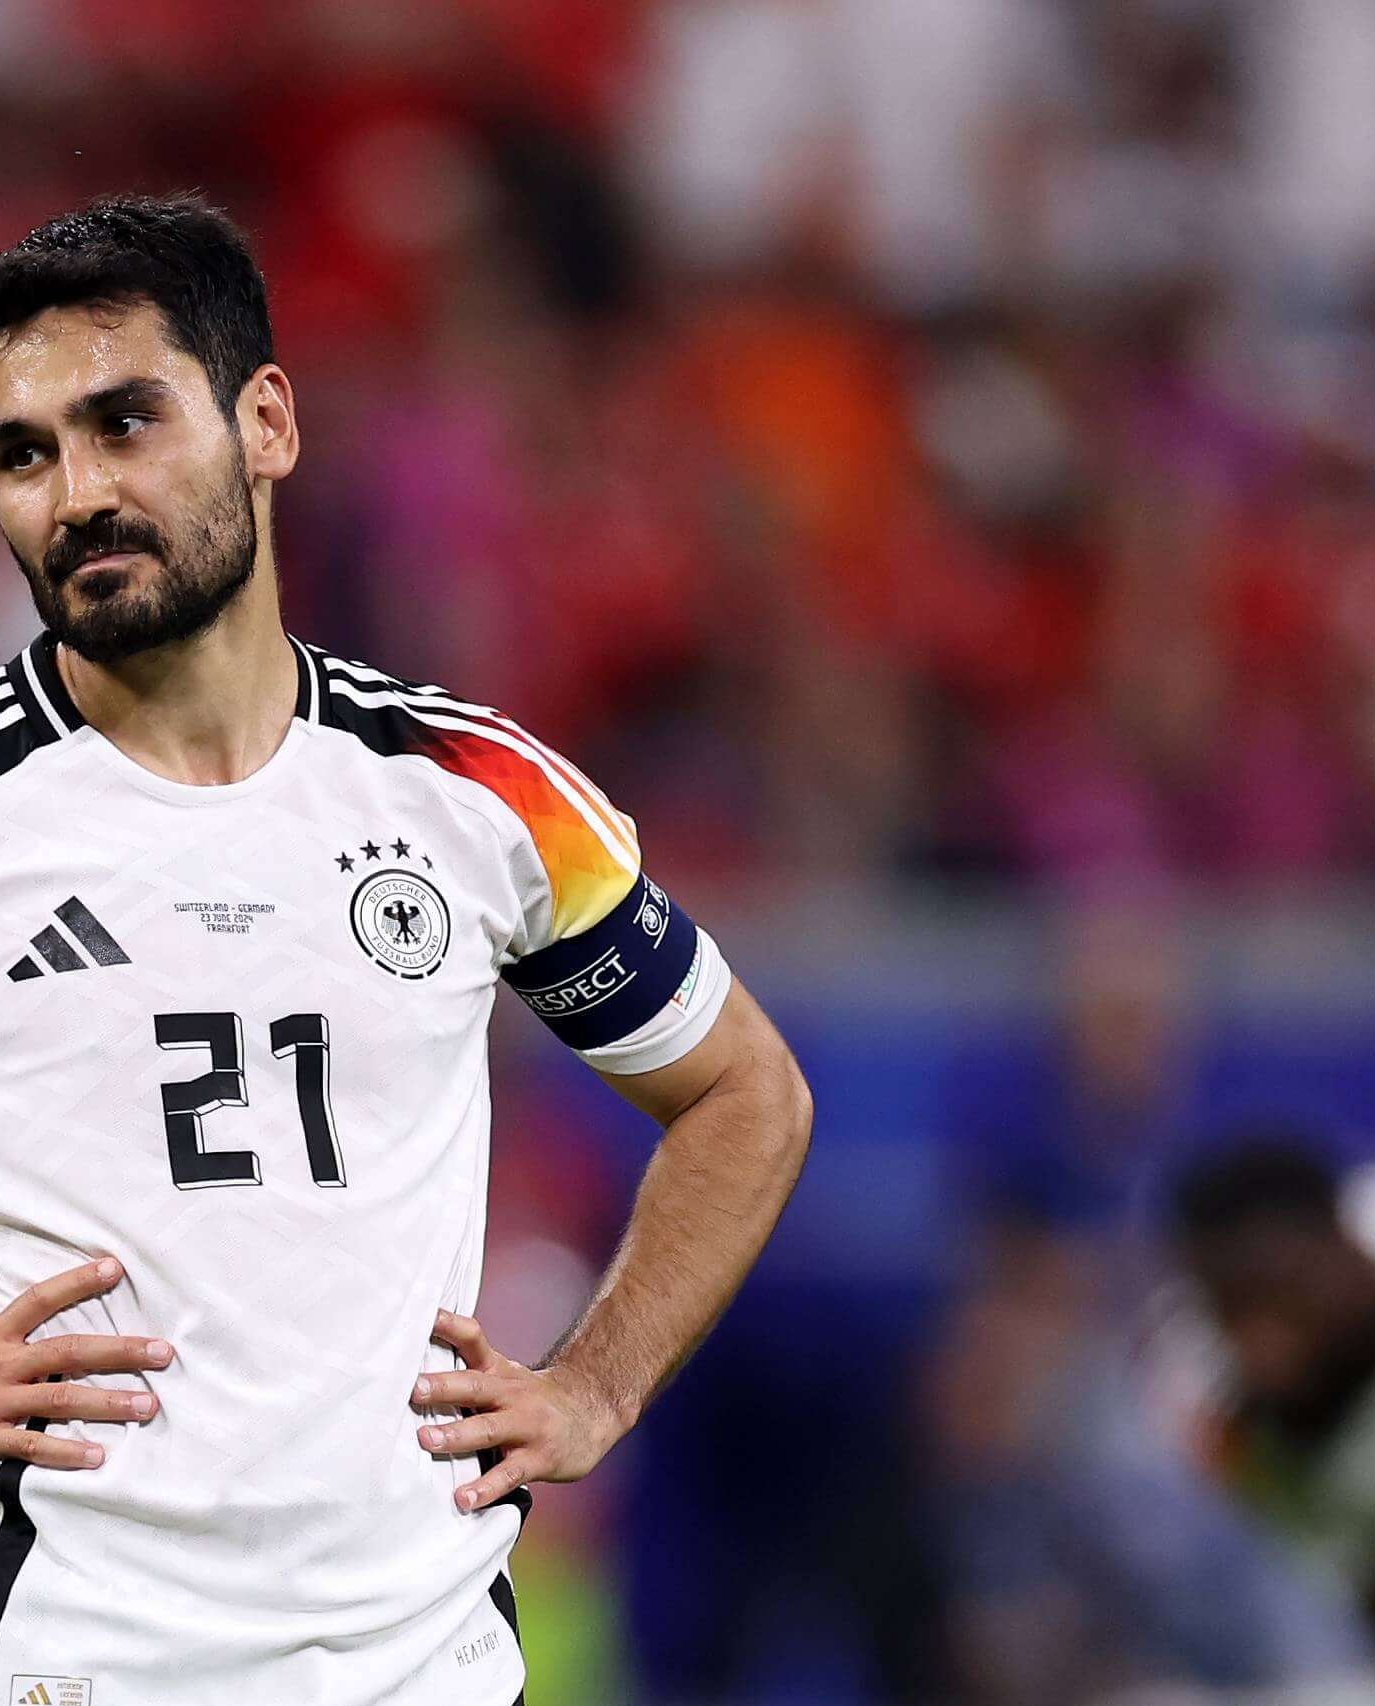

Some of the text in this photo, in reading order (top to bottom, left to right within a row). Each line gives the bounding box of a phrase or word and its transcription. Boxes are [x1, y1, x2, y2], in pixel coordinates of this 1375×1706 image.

[368, 883, 427, 904] DEUTSCHER
[174, 902, 229, 912] SWITZERLAND
[238, 903, 276, 913] GERMANY
[200, 913, 254, 924] 23 JUNE 2024
[206, 923, 251, 934] FRANKFURT
[154, 1012, 347, 1191] 21
